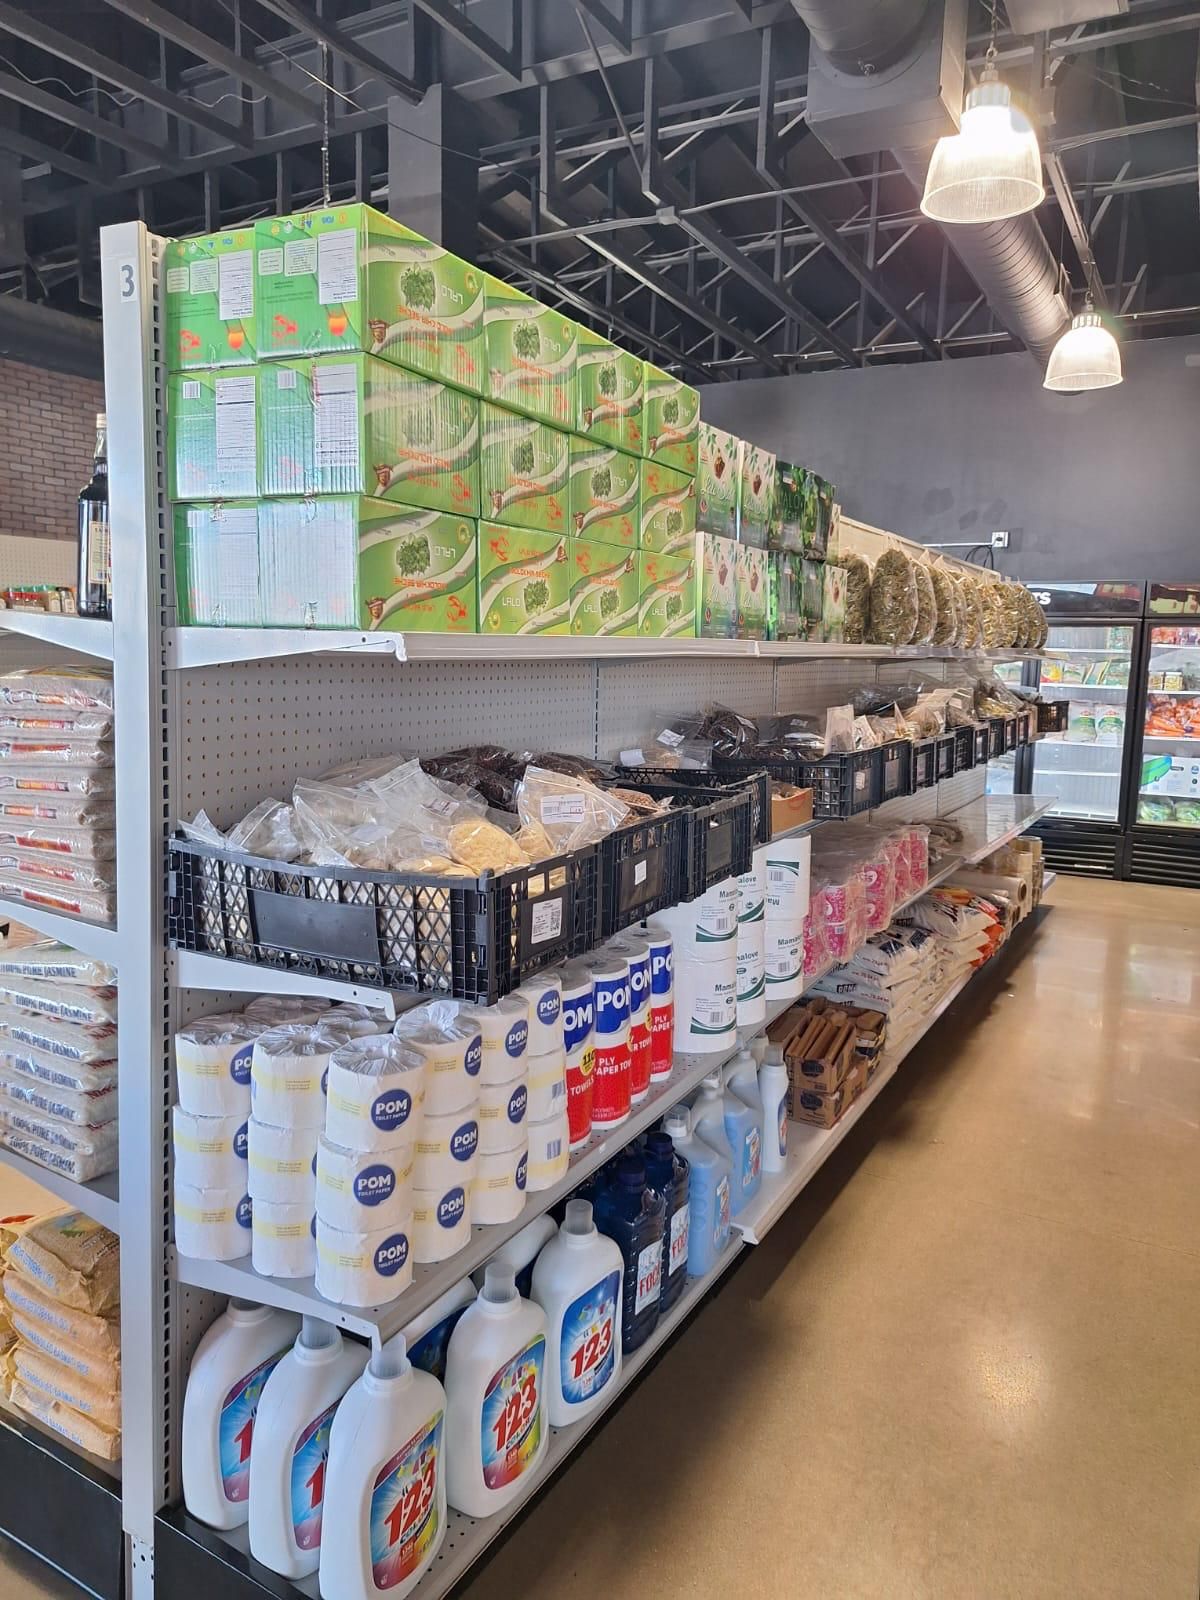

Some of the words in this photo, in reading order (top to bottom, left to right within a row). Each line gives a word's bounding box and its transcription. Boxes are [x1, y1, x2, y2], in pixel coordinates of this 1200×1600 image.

[121, 264, 135, 298] 3
[441, 284, 464, 305] LALO
[432, 545, 456, 559] LALO
[502, 597, 521, 607] LALO
[44, 966, 77, 978] JASMINE
[15, 994, 37, 1009] 100%
[39, 1000, 58, 1014] PURE
[60, 1003, 93, 1022] JASMINE
[563, 1003, 593, 1032] OM
[654, 1015, 668, 1025] PLY
[651, 1022, 671, 1033] APER
[32, 1035, 51, 1051] PURE
[599, 1056, 616, 1066] PLY
[594, 1063, 618, 1077] APER
[570, 1075, 594, 1097] TOWELS
[31, 1094, 48, 1111] PURE
[375, 1098, 409, 1115] POM
[375, 1113, 393, 1122] TOILET
[12, 1115, 31, 1133] 100%
[32, 1123, 49, 1142] PURE
[454, 1129, 477, 1148] POM
[32, 1144, 48, 1162] PURE
[357, 1173, 392, 1190] POM
[358, 1188, 375, 1197] TOILET
[375, 1186, 391, 1195] PAPER
[440, 1195, 464, 1216] POM
[378, 1242, 408, 1262] POM
[378, 1259, 393, 1268] TOILET
[570, 1318, 612, 1379] 123
[492, 1374, 537, 1452] 123
[384, 1456, 437, 1547] 123
